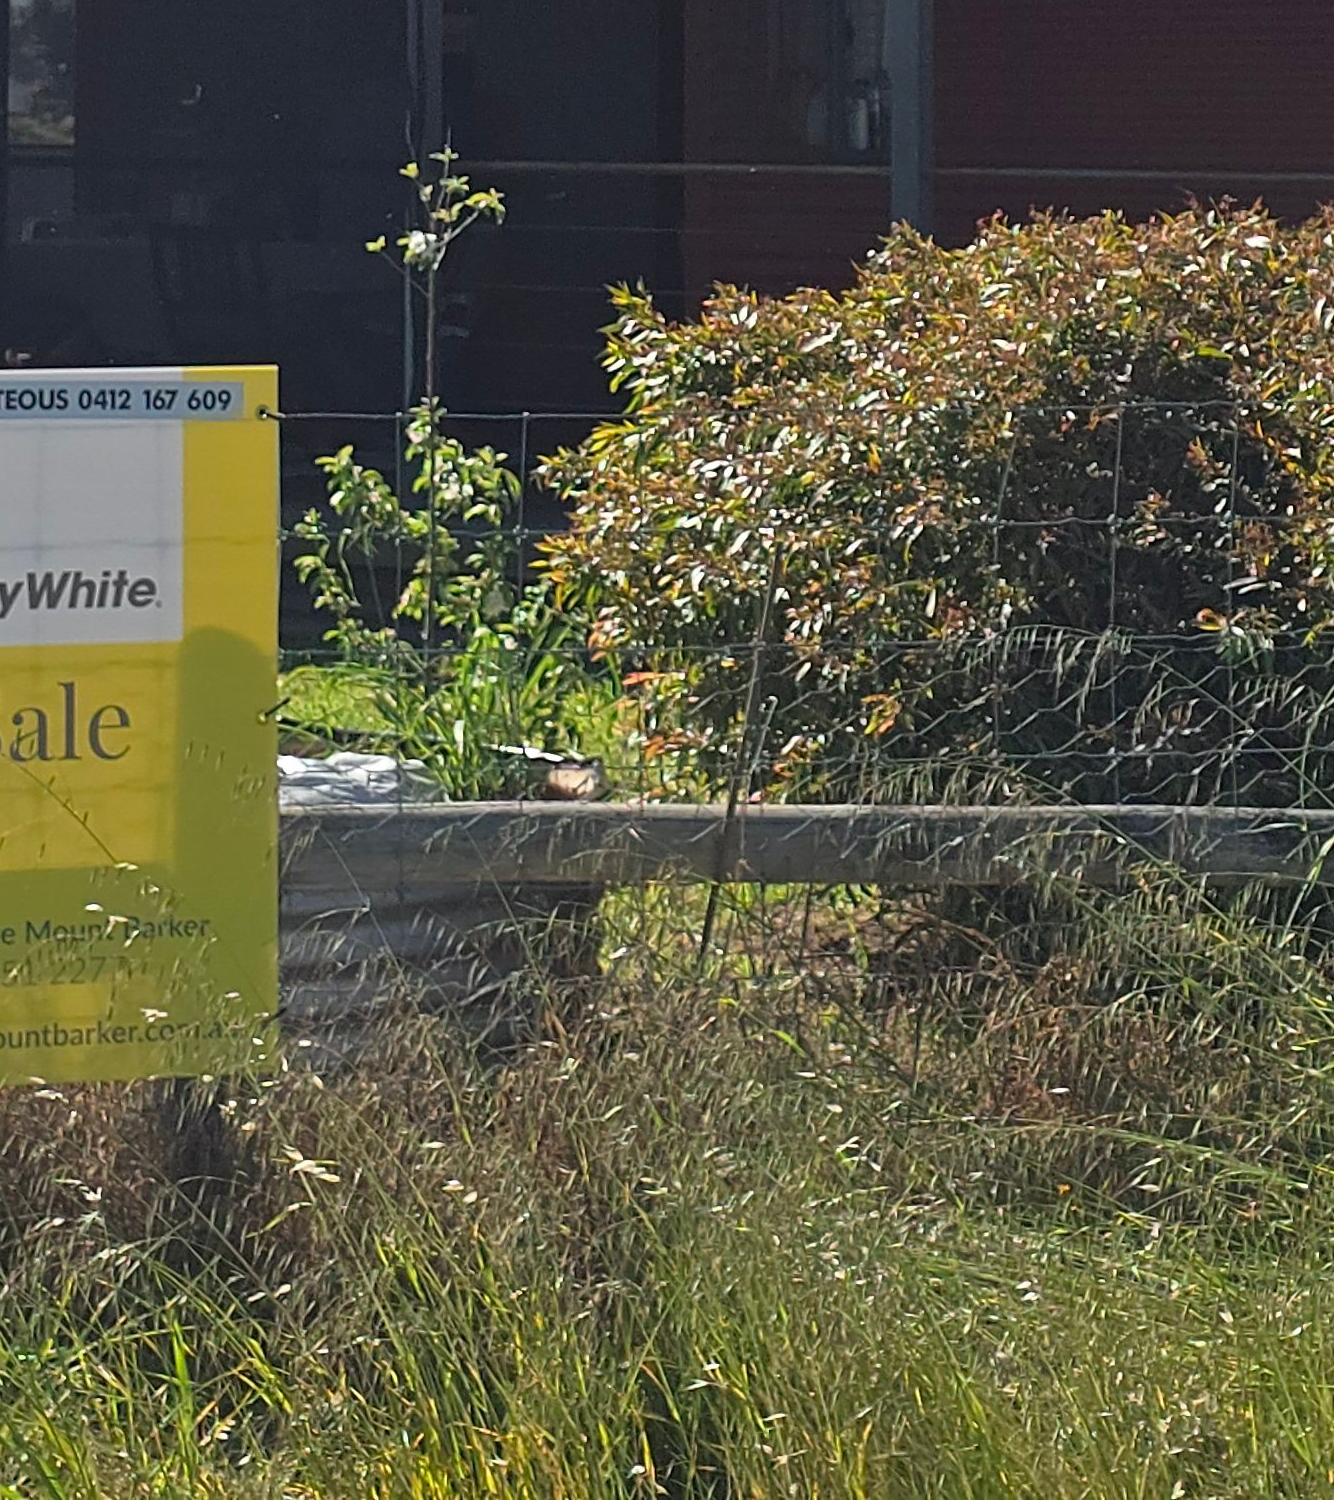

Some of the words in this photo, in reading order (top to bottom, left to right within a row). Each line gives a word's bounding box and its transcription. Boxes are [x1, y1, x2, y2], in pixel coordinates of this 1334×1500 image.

[78, 388, 131, 411] 0412
[142, 388, 179, 411] 167
[188, 388, 231, 411] 609
[25, 918, 115, 944] Mount
[123, 915, 211, 940] Barker
